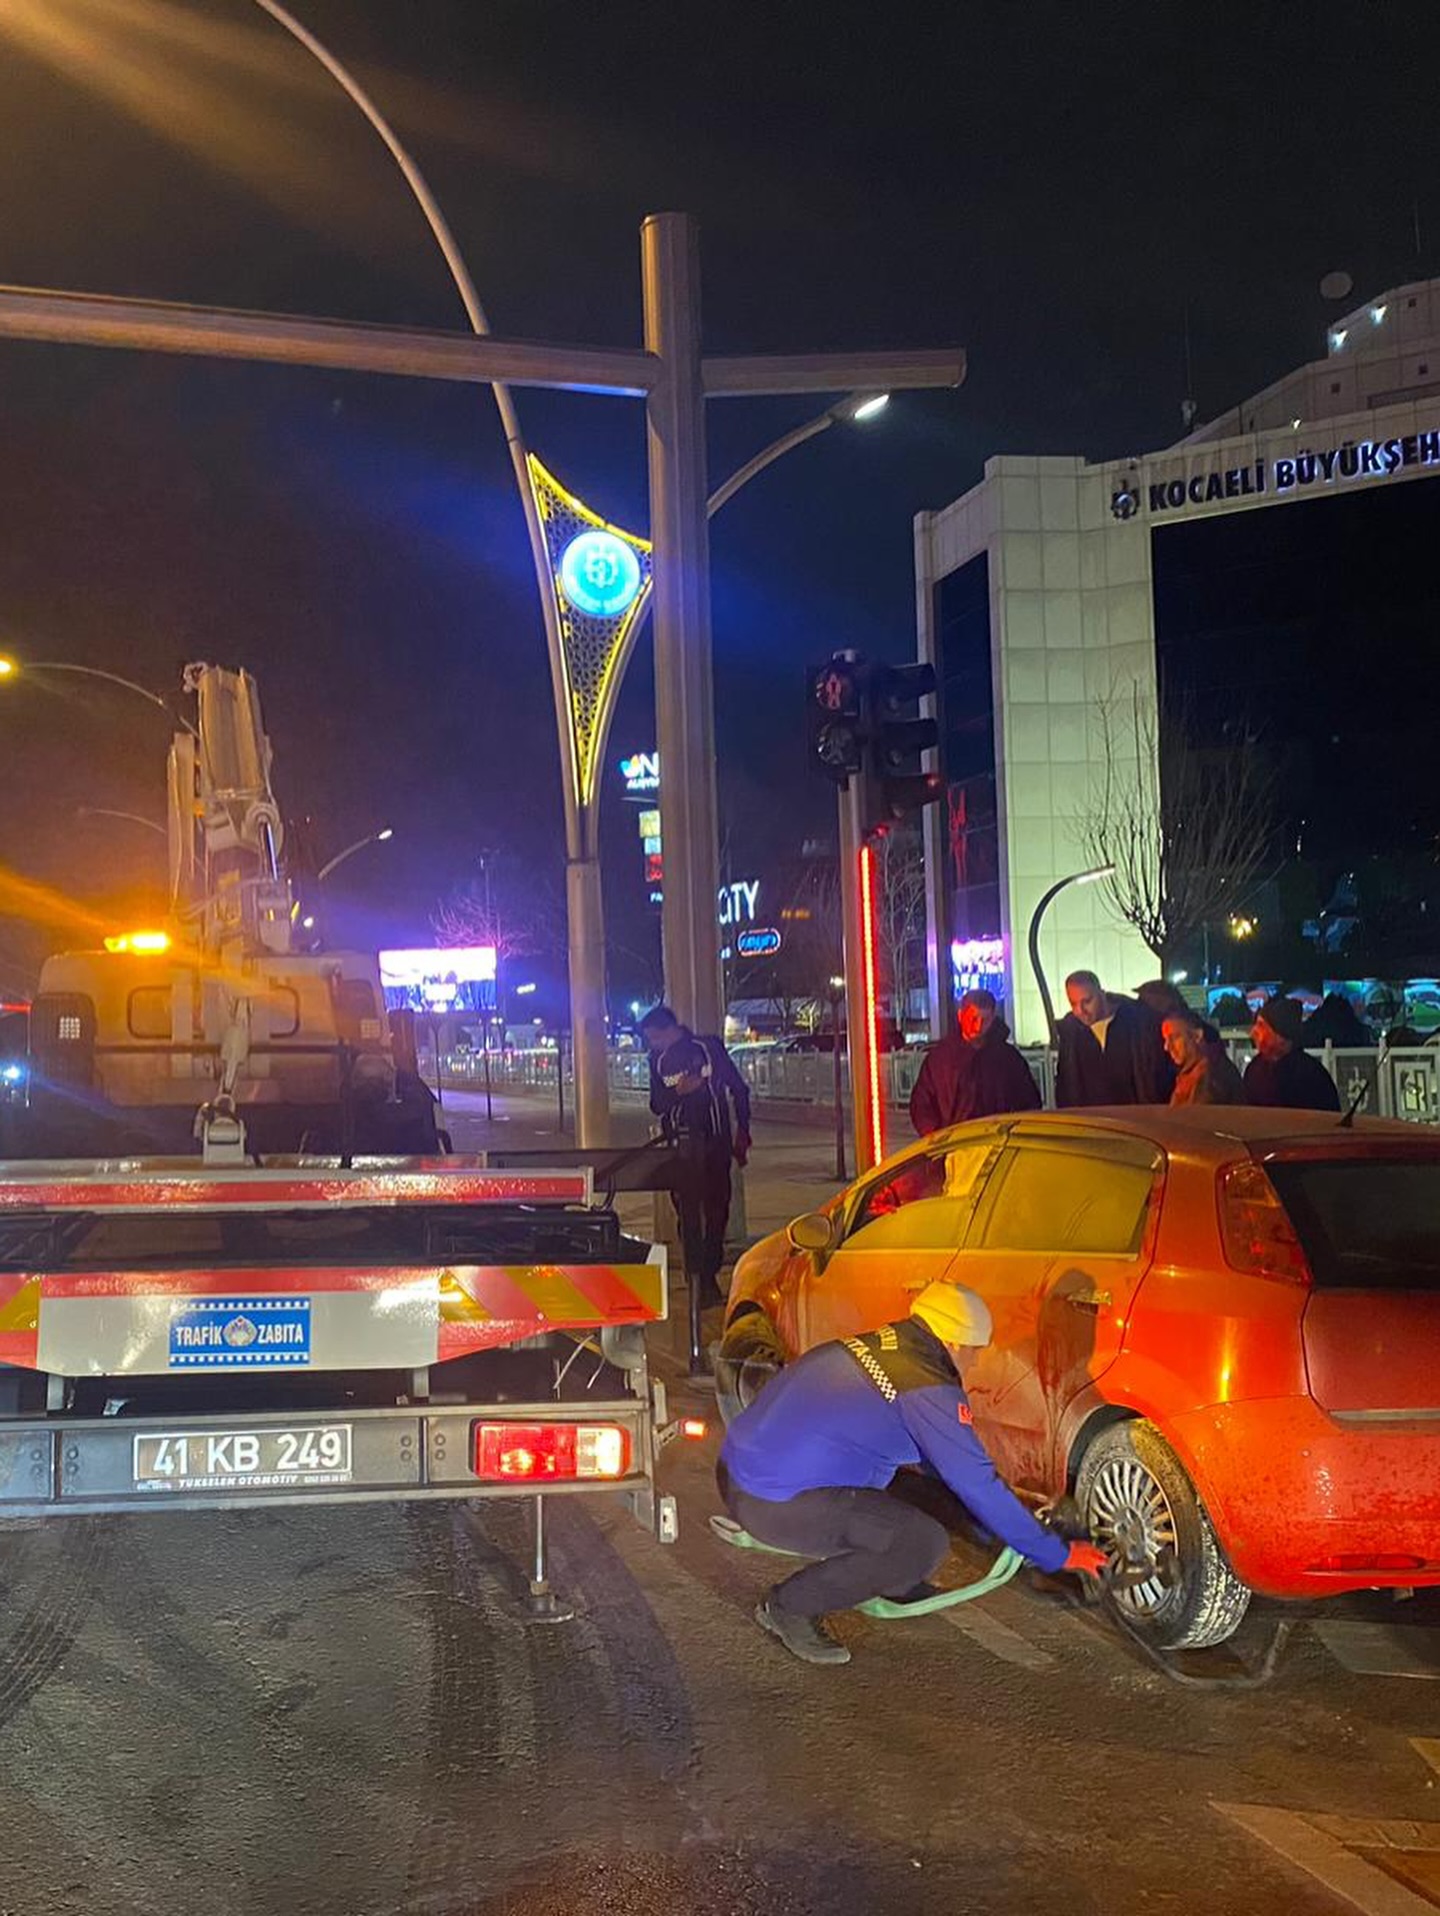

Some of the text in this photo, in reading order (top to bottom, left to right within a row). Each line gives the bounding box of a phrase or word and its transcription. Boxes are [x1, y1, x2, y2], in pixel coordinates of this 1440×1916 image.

[1149, 458, 1265, 512] KOCAELİ
[175, 1322, 304, 1346] TRAFİK ZABITA
[152, 1431, 342, 1476] 41 KB 249
